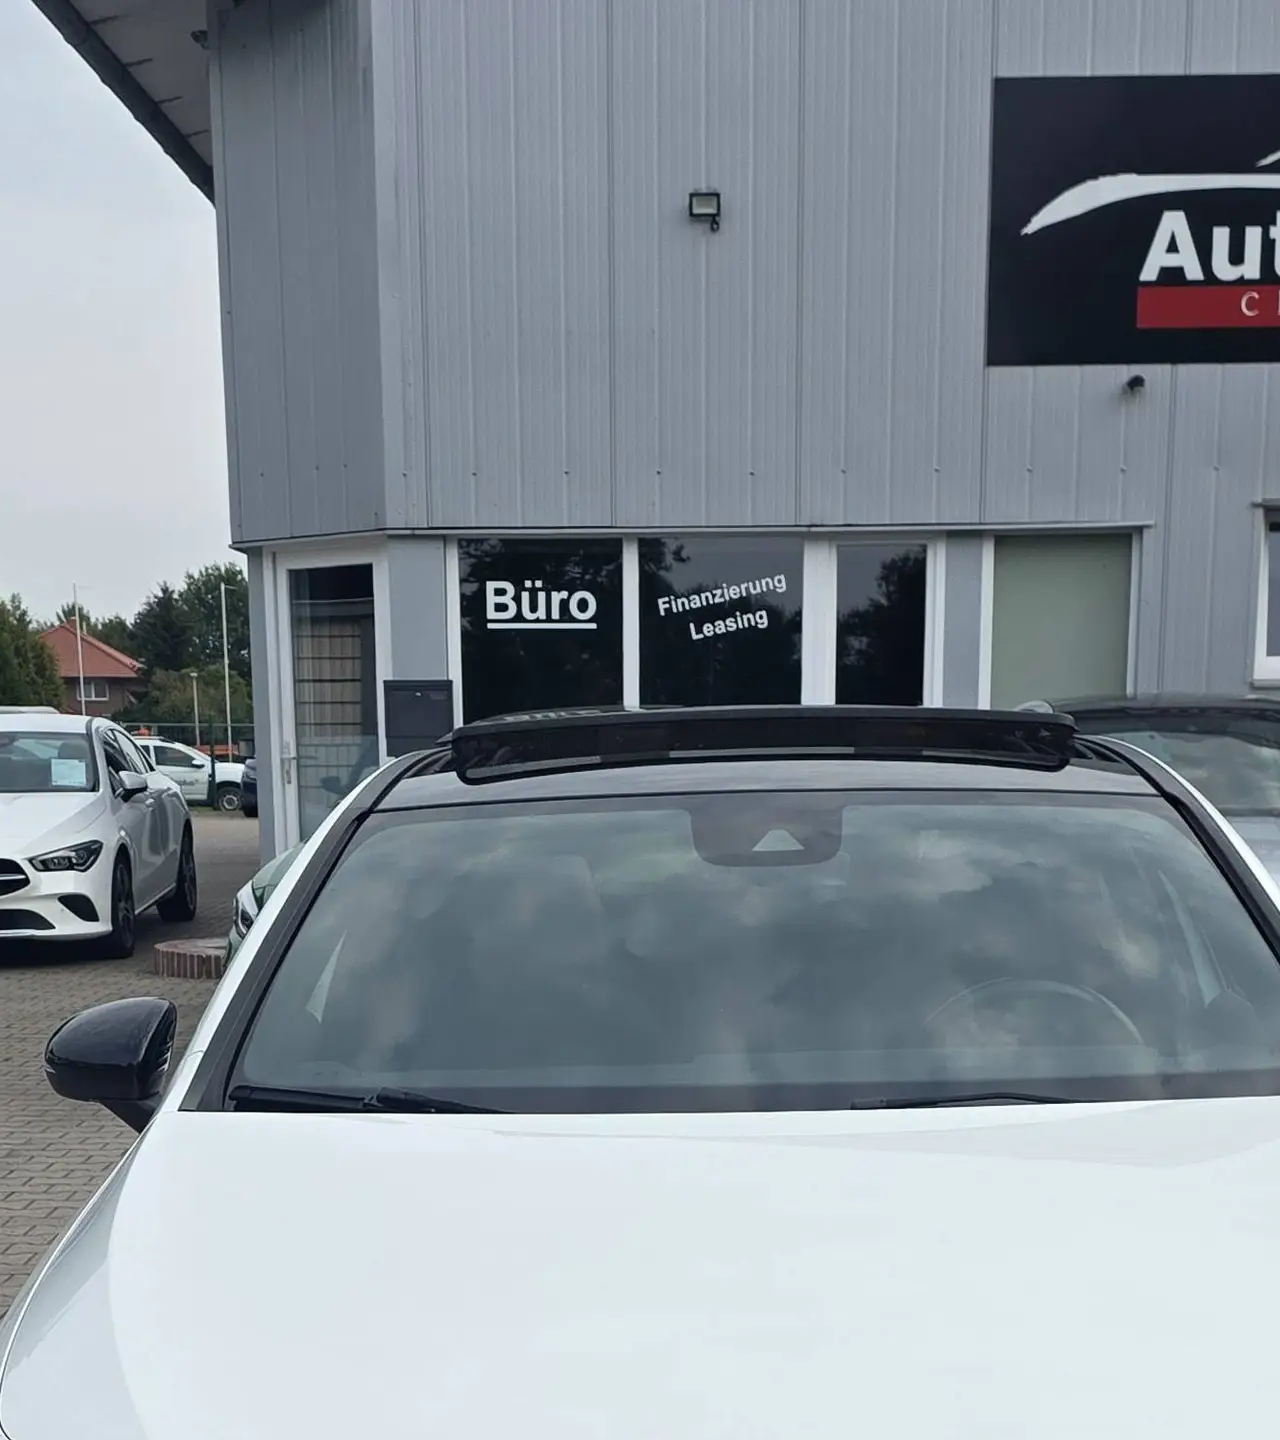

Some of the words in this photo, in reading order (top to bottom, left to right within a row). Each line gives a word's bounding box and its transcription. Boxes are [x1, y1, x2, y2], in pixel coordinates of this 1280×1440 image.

[485, 580, 597, 621] Büro
[657, 573, 787, 617] Finanzierung
[689, 609, 769, 640] Leasing
